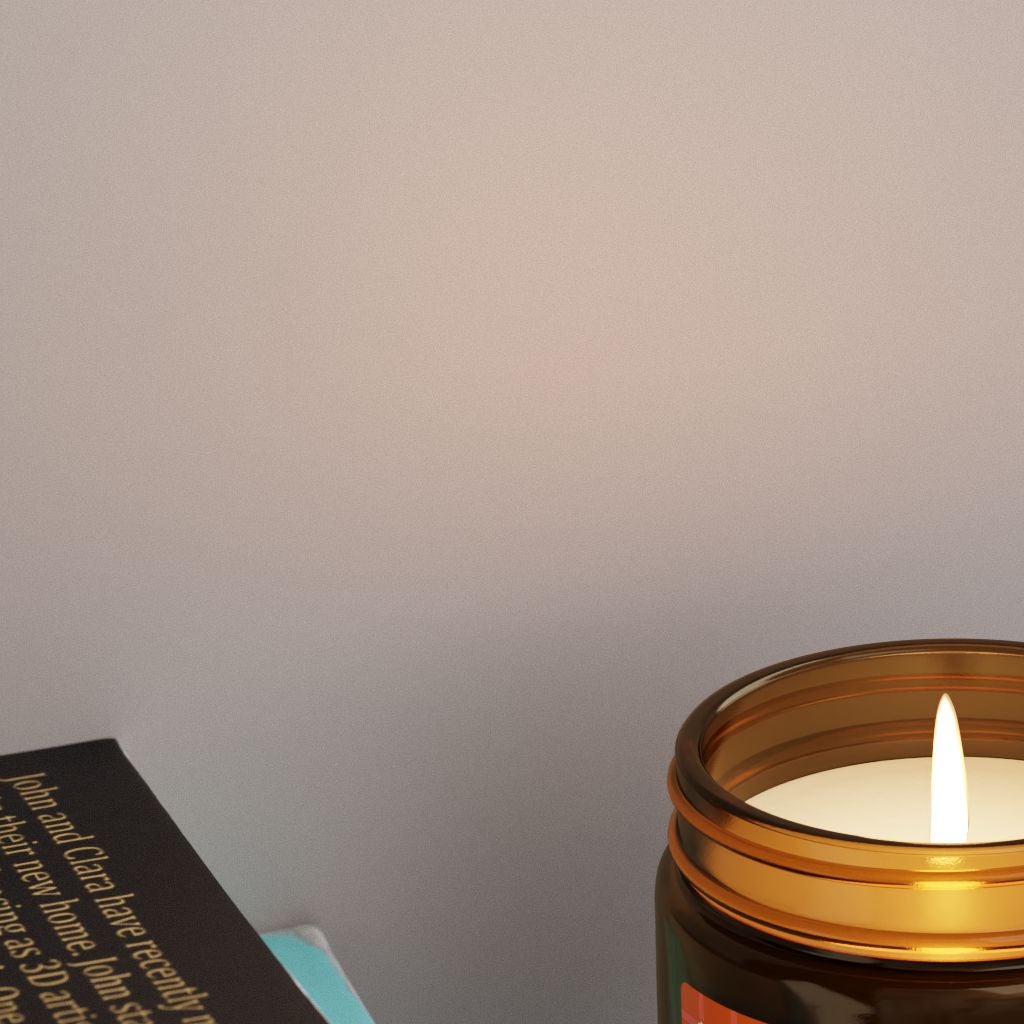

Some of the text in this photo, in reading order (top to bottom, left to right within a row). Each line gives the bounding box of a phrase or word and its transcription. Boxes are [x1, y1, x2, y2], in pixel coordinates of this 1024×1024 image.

[0, 772, 58, 811] John
[37, 812, 95, 845] and
[13, 859, 61, 896] new
[63, 846, 116, 893] Clara
[39, 898, 96, 957] home.
[93, 893, 147, 938] have
[4, 937, 42, 959] as
[19, 959, 70, 987] 3D
[66, 956, 132, 1001] John
[125, 939, 209, 1011] recently
